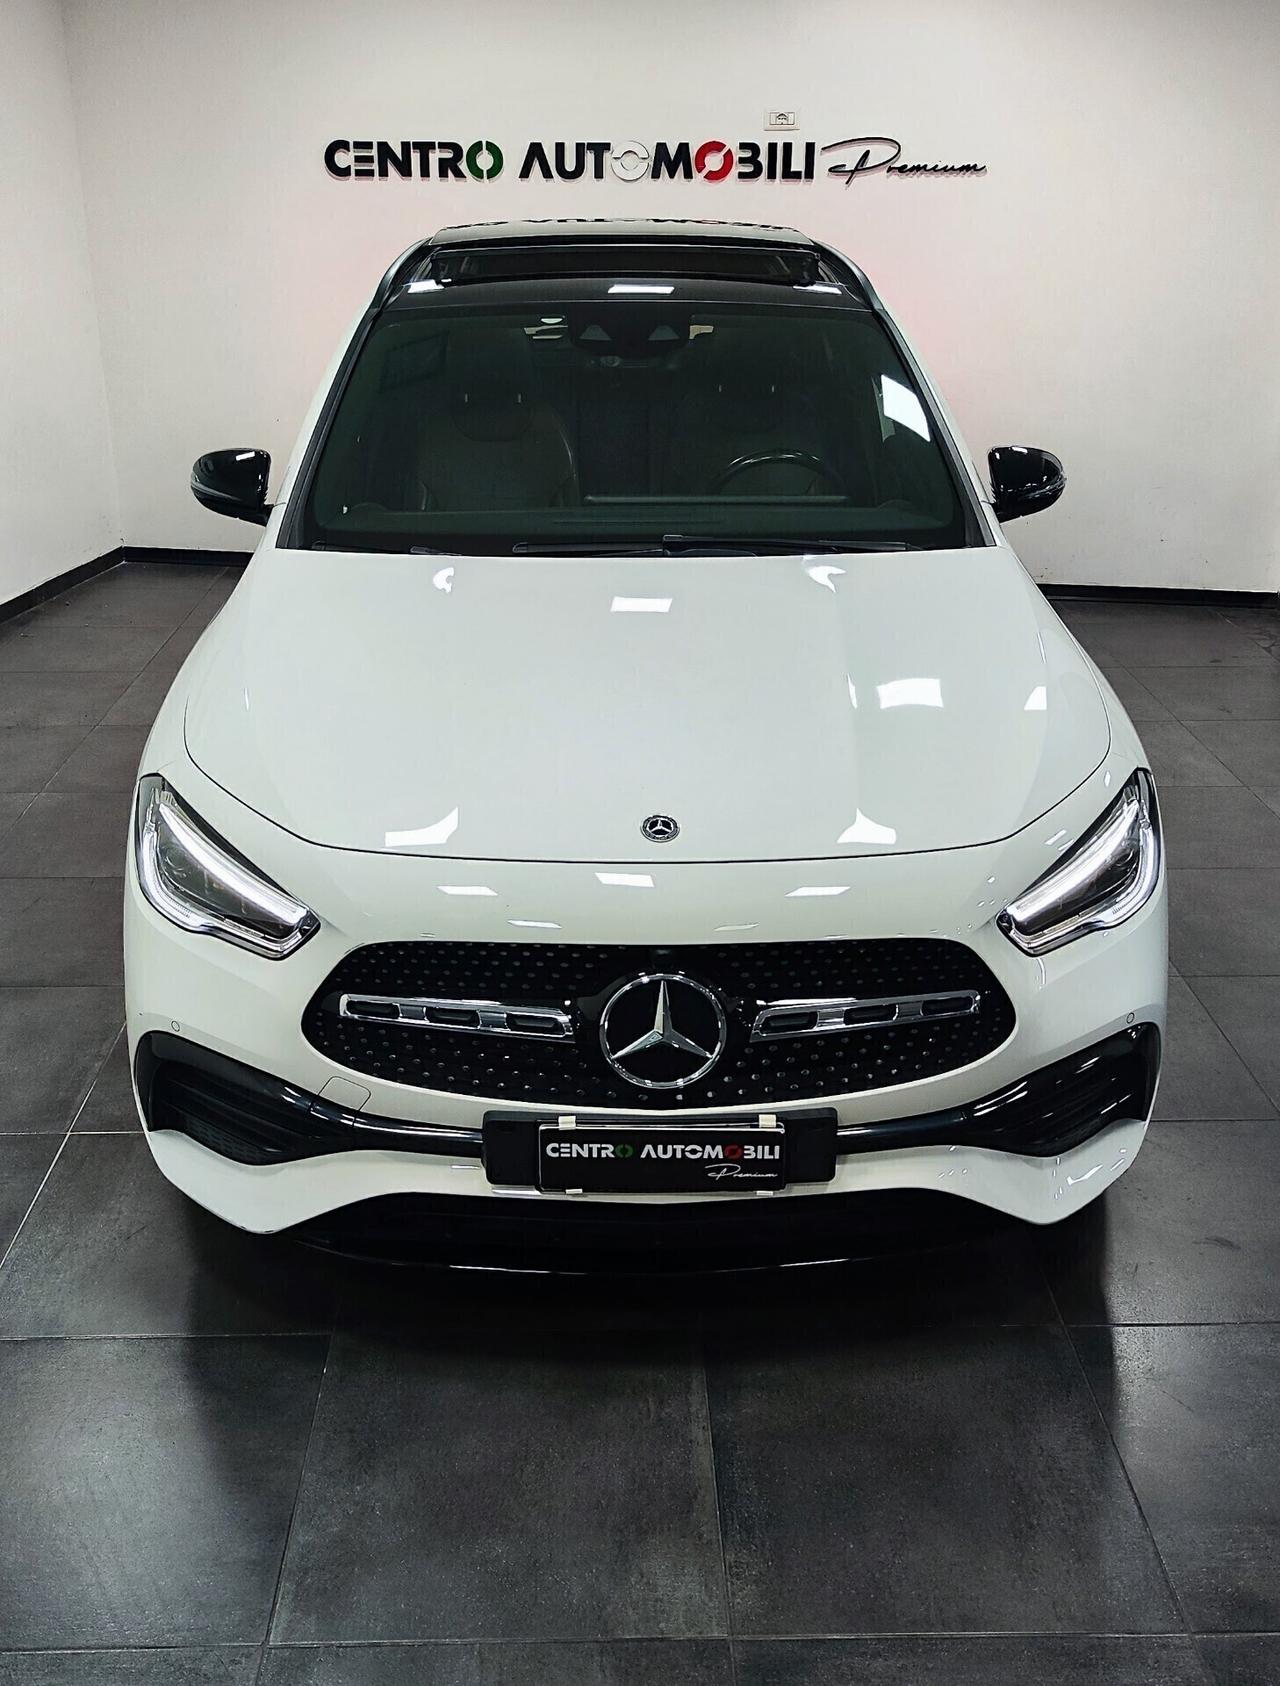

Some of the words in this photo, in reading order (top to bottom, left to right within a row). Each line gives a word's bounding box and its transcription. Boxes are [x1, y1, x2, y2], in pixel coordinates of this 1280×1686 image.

[324, 139, 504, 182] CENTRO
[518, 140, 816, 182] AUTOMOBILI
[821, 136, 988, 188] Premium
[545, 1142, 634, 1158] CENTRO
[640, 1144, 780, 1160] AUTOMOBILI
[704, 1163, 778, 1181] Premium
